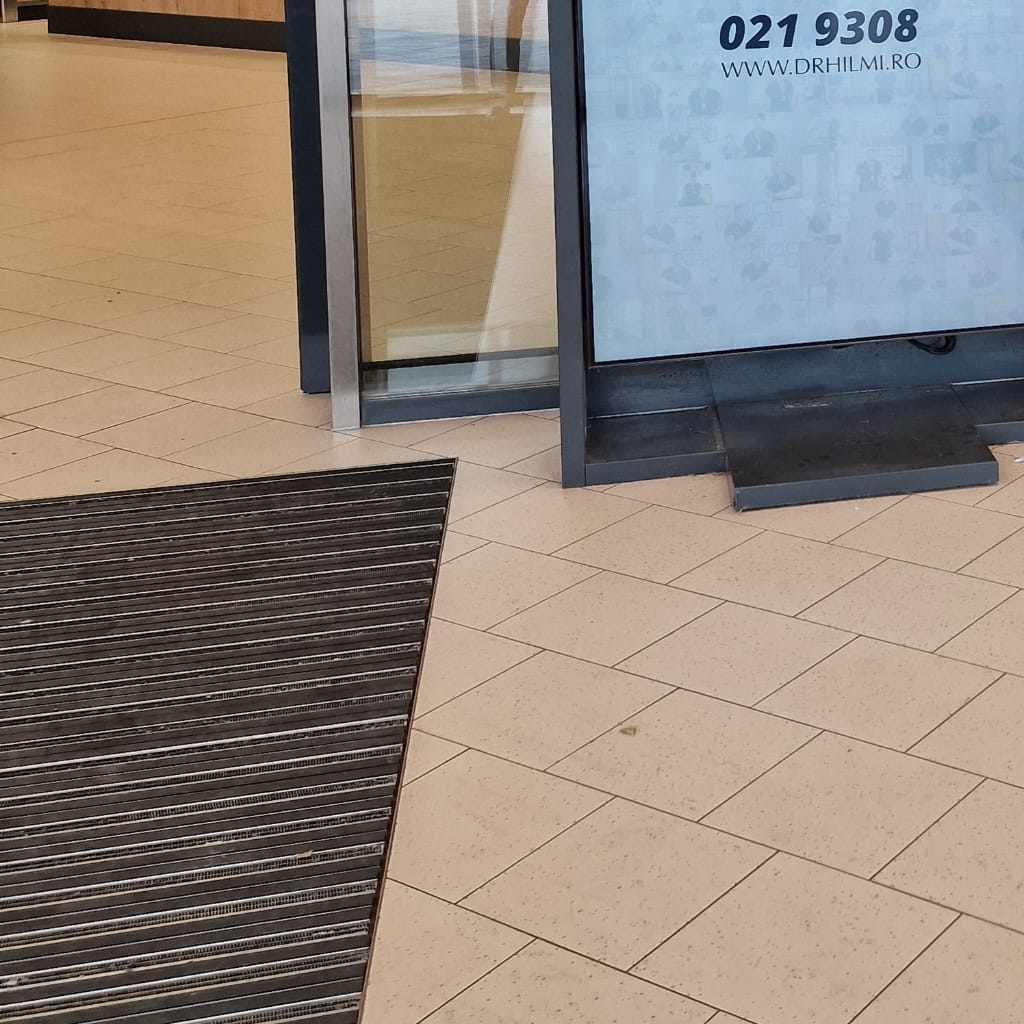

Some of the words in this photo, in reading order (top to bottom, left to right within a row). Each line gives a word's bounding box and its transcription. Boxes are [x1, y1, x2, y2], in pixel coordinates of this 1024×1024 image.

[720, 13, 799, 51] 021
[814, 8, 919, 47] 9308
[720, 52, 922, 78] WWW.DRHILMI.RO
